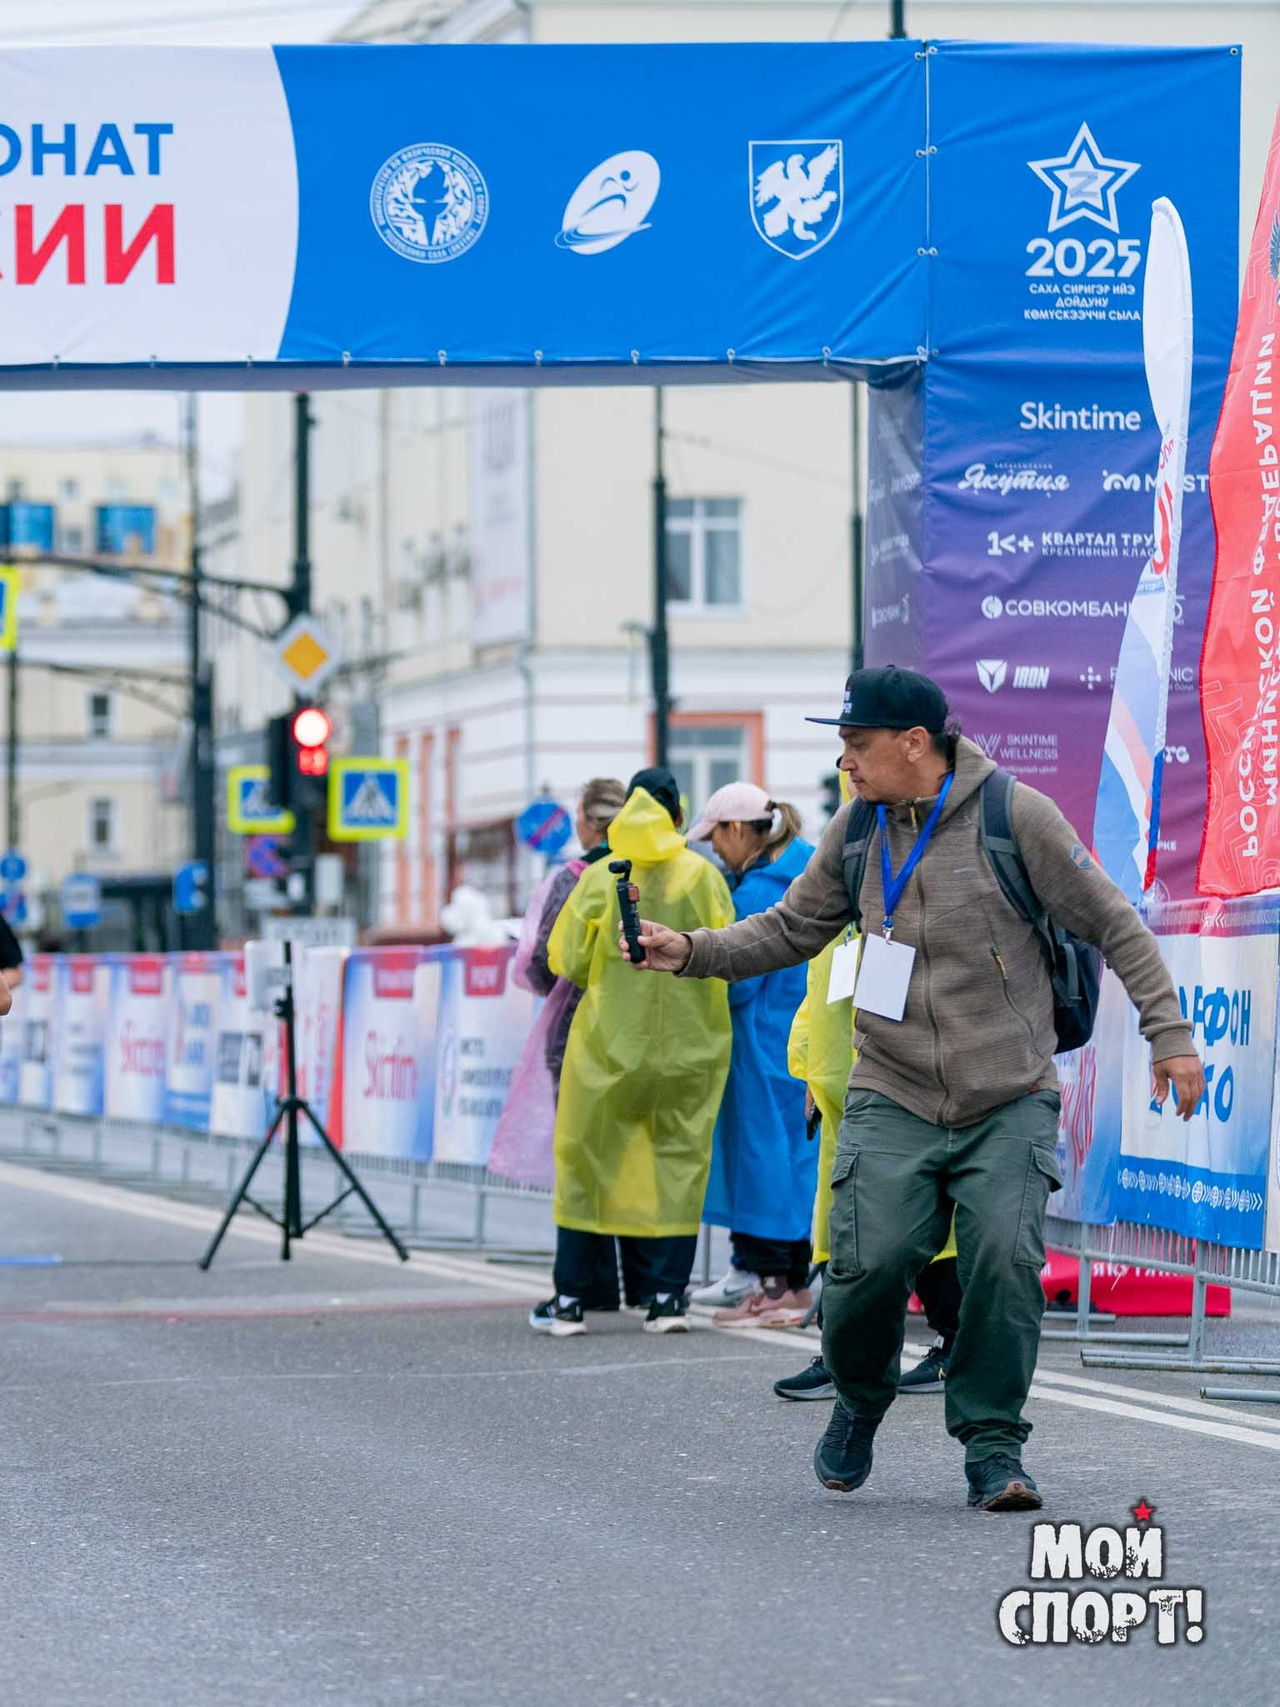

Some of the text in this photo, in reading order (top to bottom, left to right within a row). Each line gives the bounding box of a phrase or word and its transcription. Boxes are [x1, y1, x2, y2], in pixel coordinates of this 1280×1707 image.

[1025, 237, 1142, 278] 2025
[1029, 281, 1136, 295] САХА СИРИГЭР ИЙЭ
[1055, 295, 1109, 308] ДОЙДУНУ
[1108, 309, 1142, 321] СЫЛА
[1020, 401, 1141, 431] Skintime
[958, 463, 1070, 496] Якутия
[1042, 532, 1155, 547] КВАРТАЛ ТРУ
[1042, 547, 1157, 558] КРЕАТИВНЫЙ КЛАС
[1005, 600, 1131, 618] СОВКОМБАН
[1013, 666, 1050, 690] IRON
[1007, 733, 1059, 746] SKINTIME
[1000, 747, 1059, 760] WELLNESS
